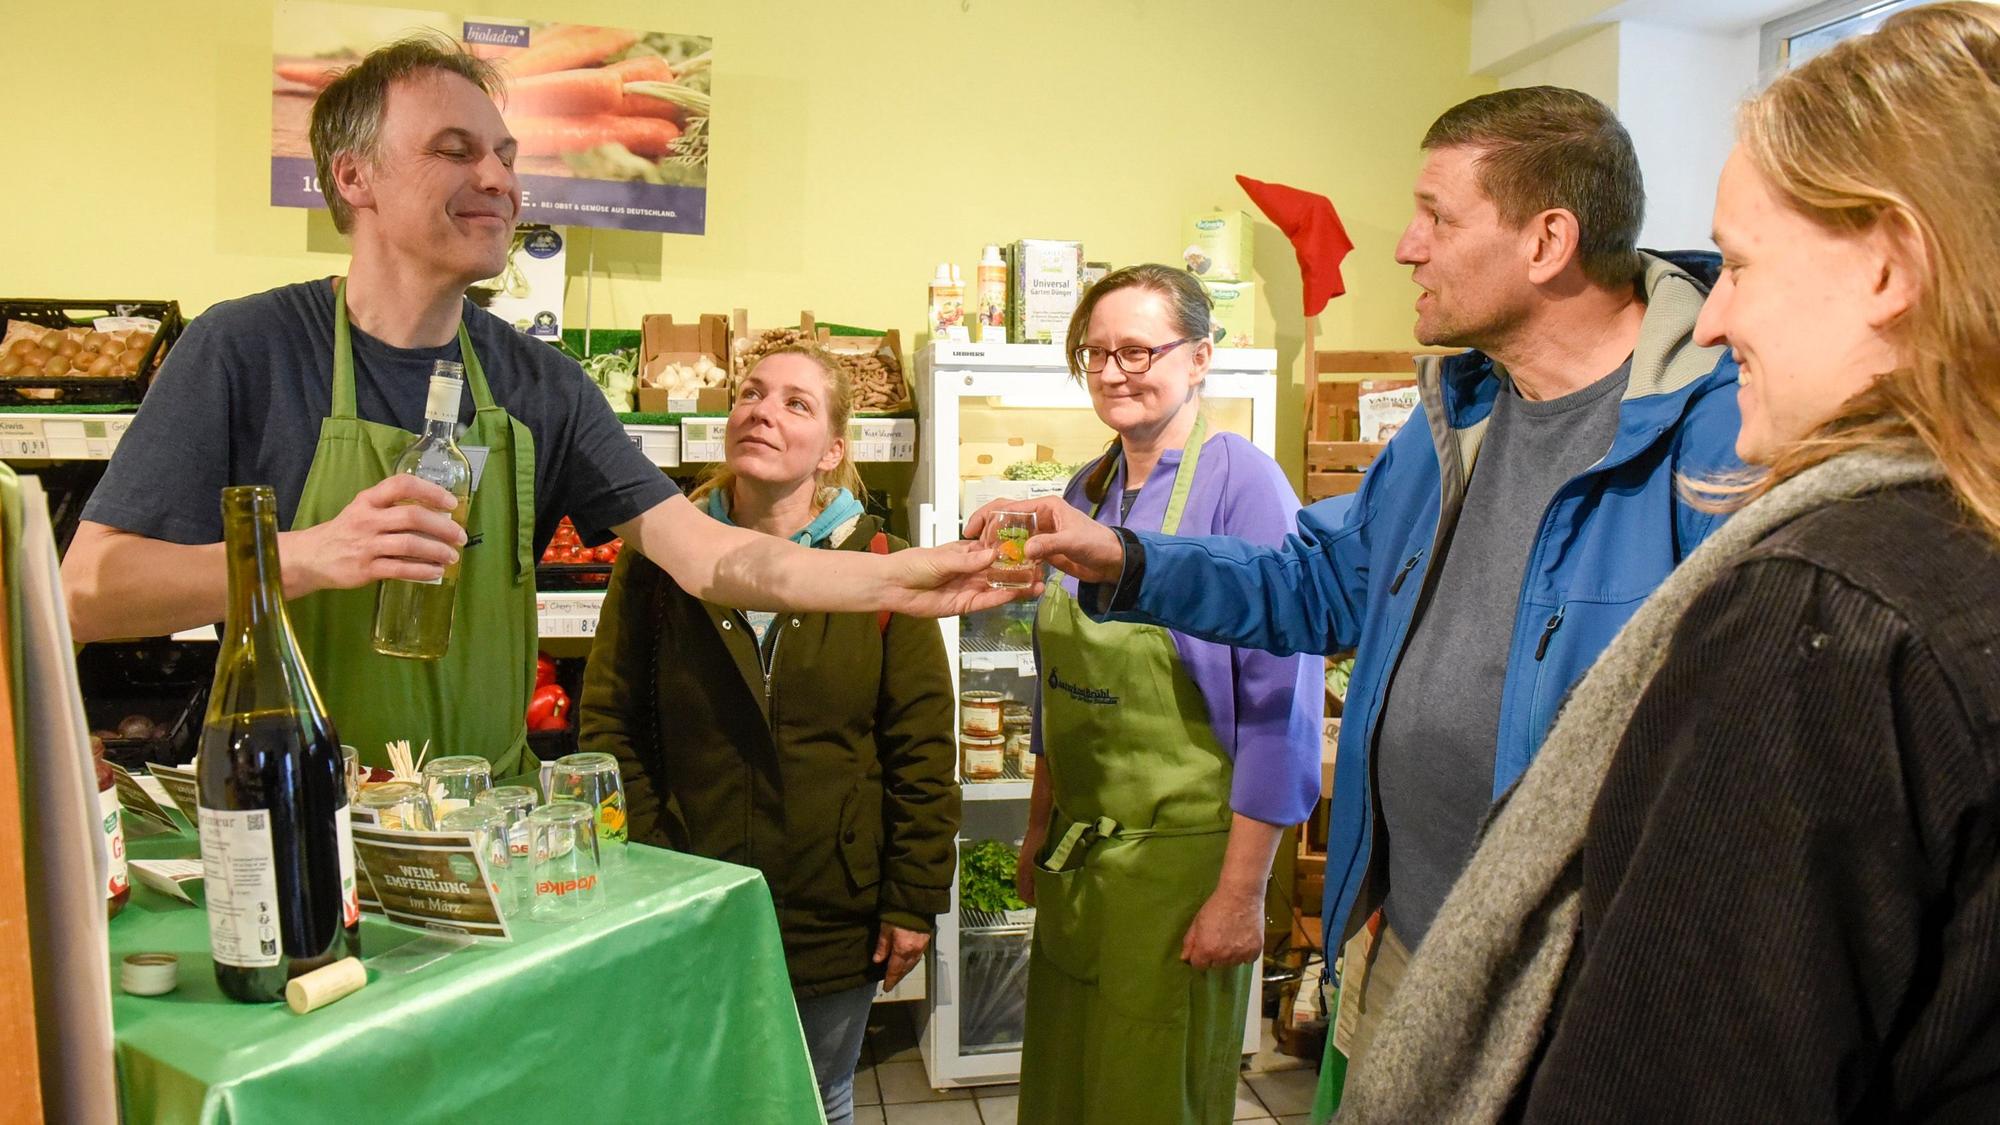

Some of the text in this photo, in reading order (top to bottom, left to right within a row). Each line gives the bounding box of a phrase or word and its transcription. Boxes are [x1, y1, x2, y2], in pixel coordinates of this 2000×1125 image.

[303, 175, 323, 193] 10
[521, 191, 537, 207] E.
[554, 202, 573, 210] OBST
[574, 203, 579, 211] &
[581, 204, 609, 213] GEMÜSE
[611, 206, 625, 214] AUS
[626, 207, 678, 218] DEUTSCHLAND.
[1033, 279, 1070, 289] Universal
[398, 865, 440, 880] WEIN-
[383, 874, 471, 895] EMPFEHLUNG
[408, 895, 462, 914] im März
